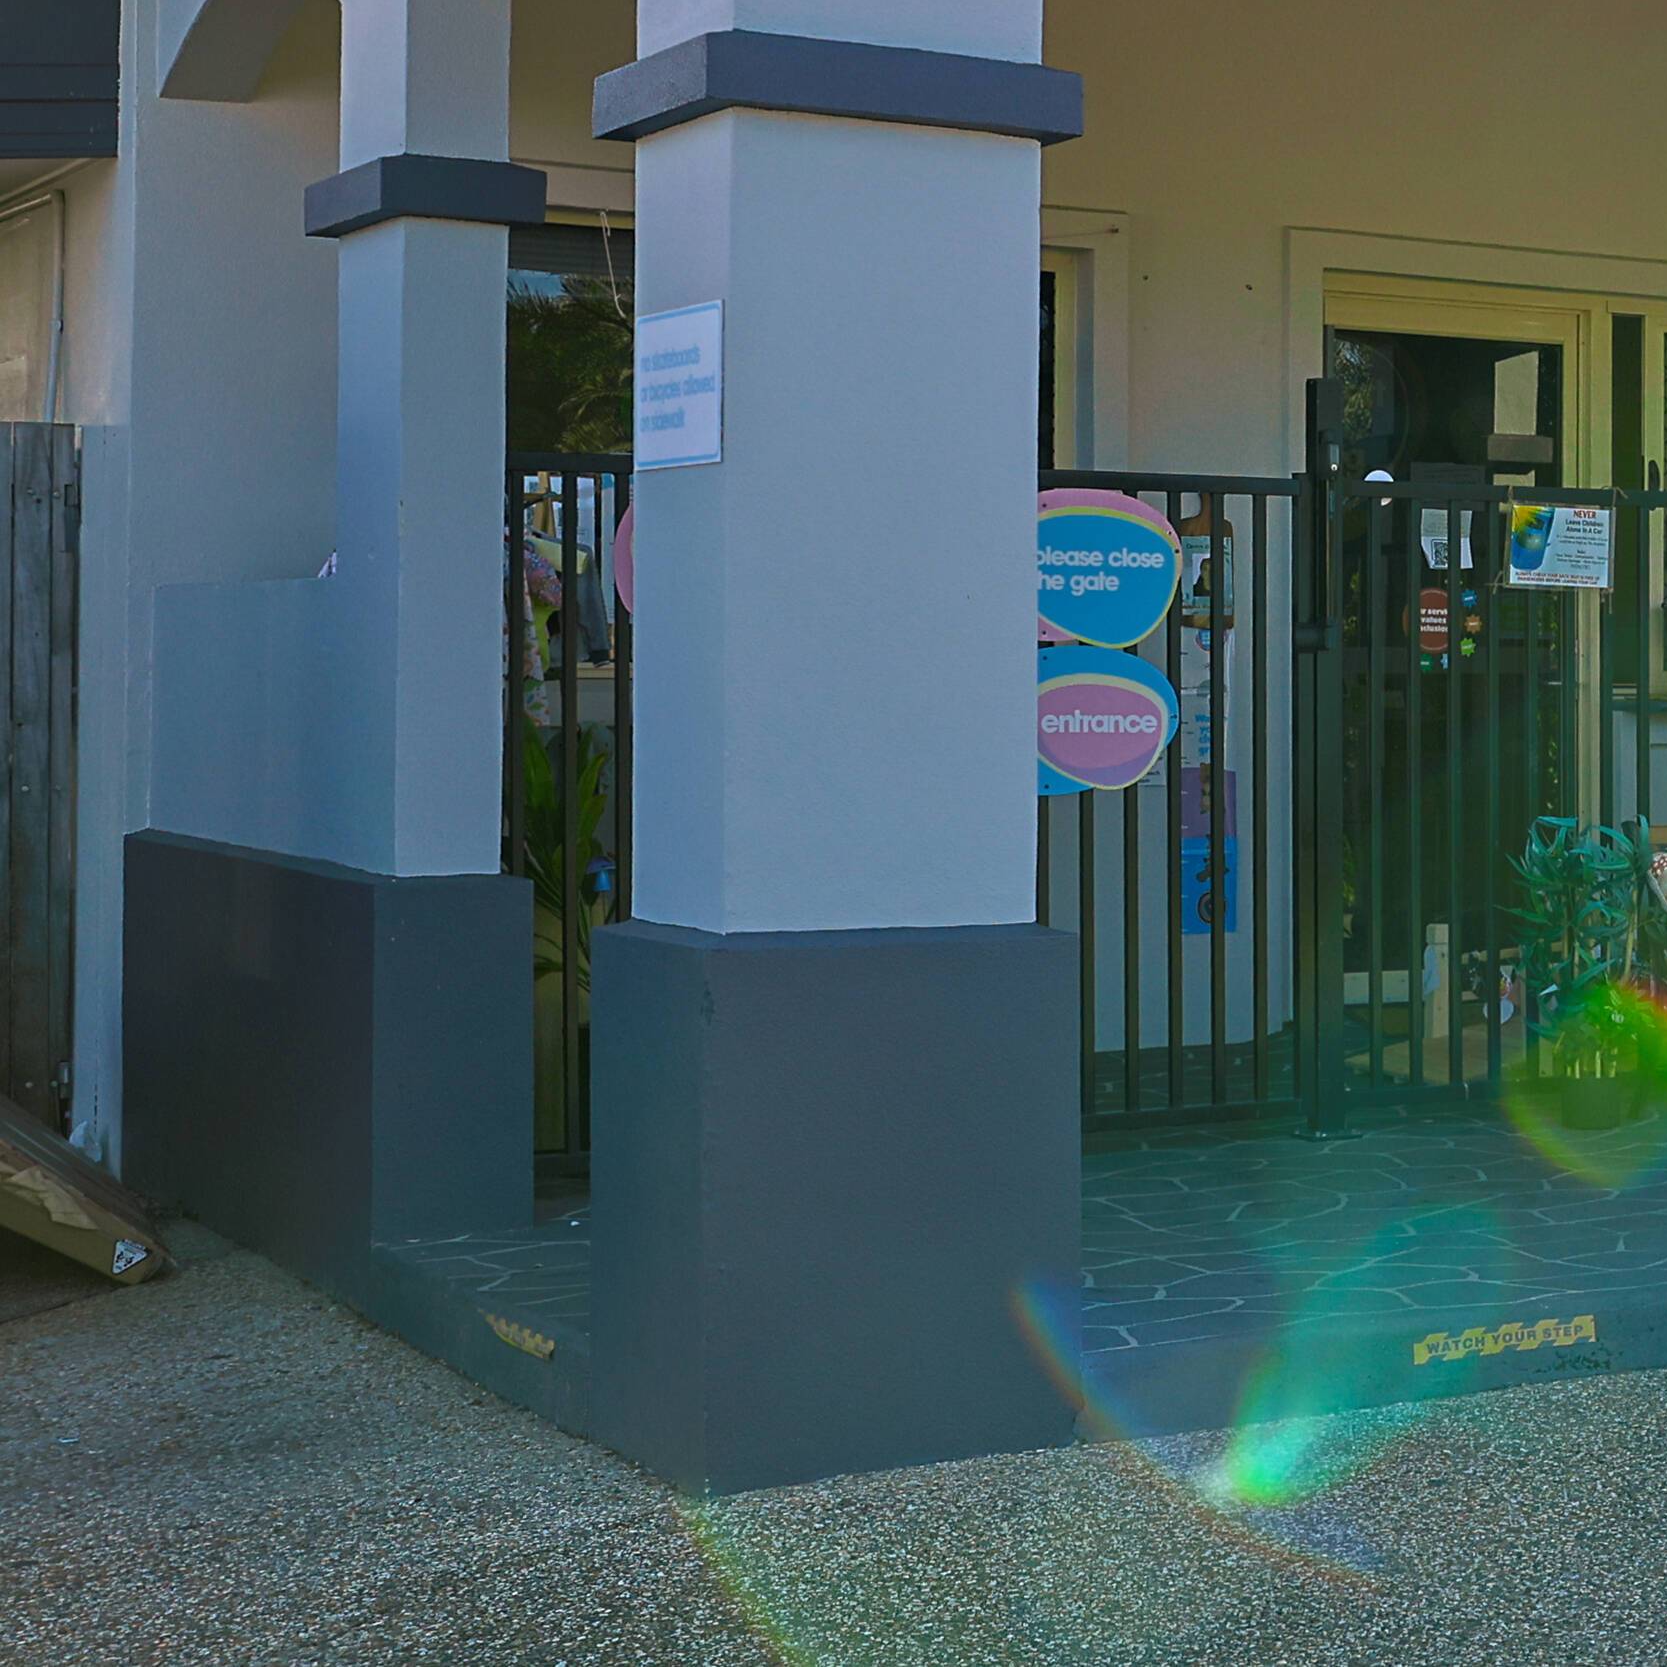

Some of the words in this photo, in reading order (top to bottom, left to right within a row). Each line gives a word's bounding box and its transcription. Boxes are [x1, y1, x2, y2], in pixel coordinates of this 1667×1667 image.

[1573, 510, 1596, 519] NEVER
[1108, 547, 1165, 569] close
[1037, 570, 1065, 591] he
[1070, 570, 1120, 597] gate
[1040, 709, 1158, 734] entrance
[1426, 1336, 1486, 1355] WATCH
[1491, 1329, 1537, 1346] YOUR
[1543, 1325, 1584, 1340] STEP
